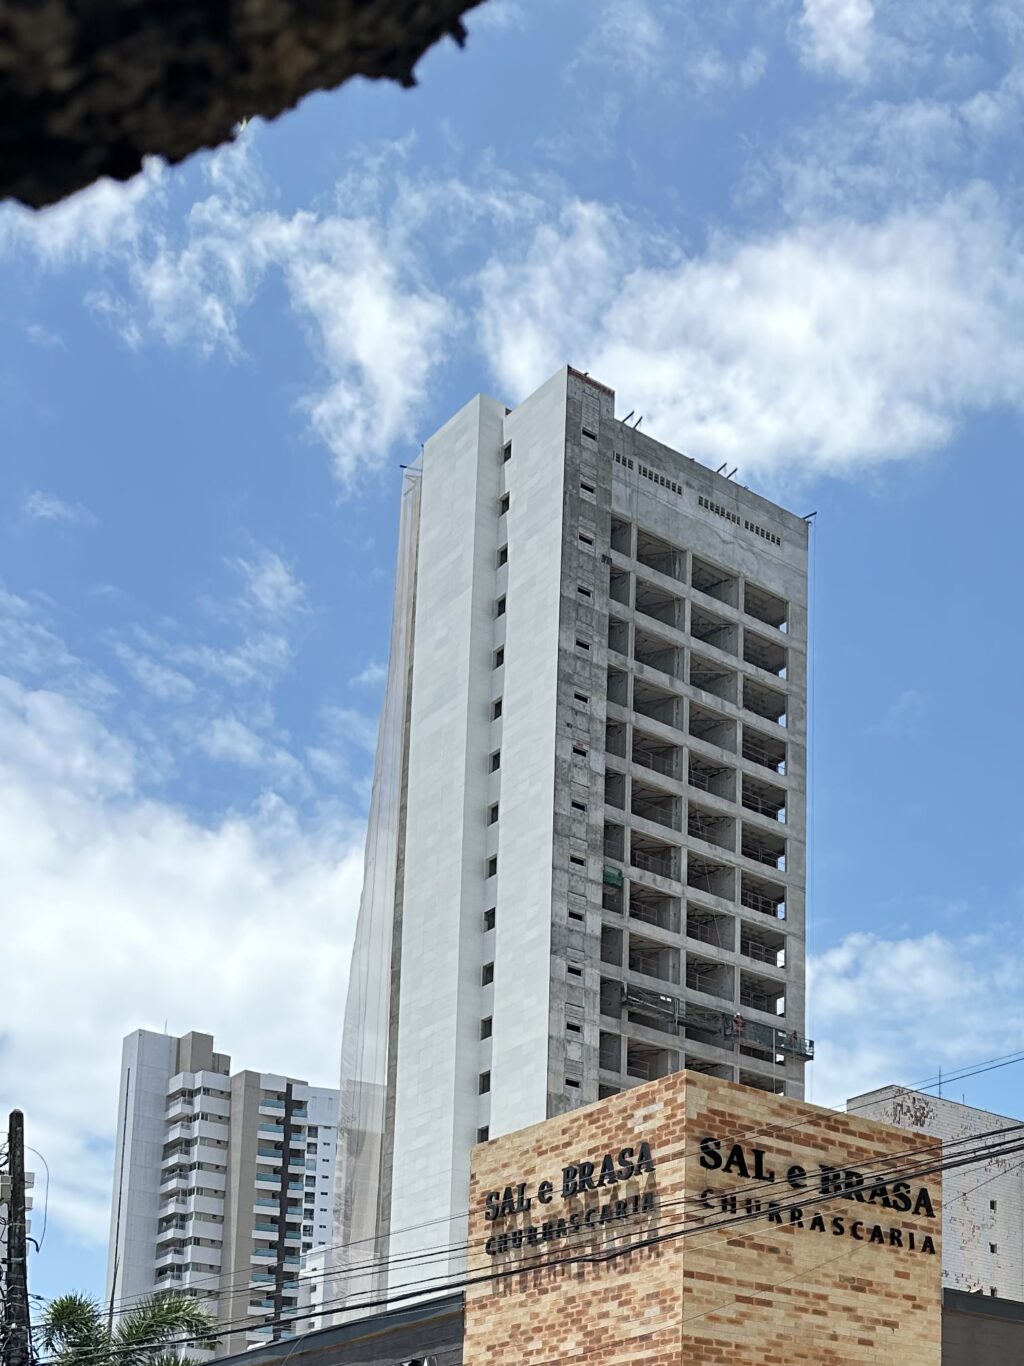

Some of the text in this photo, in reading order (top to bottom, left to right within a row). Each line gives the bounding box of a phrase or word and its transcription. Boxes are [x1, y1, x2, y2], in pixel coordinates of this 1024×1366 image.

[485, 1142, 656, 1221] SAL e BRASA
[699, 1137, 936, 1218] SAL e BRASA
[485, 1192, 655, 1255] CHURRASCARIA
[700, 1189, 936, 1255] CHURRASCARIA
